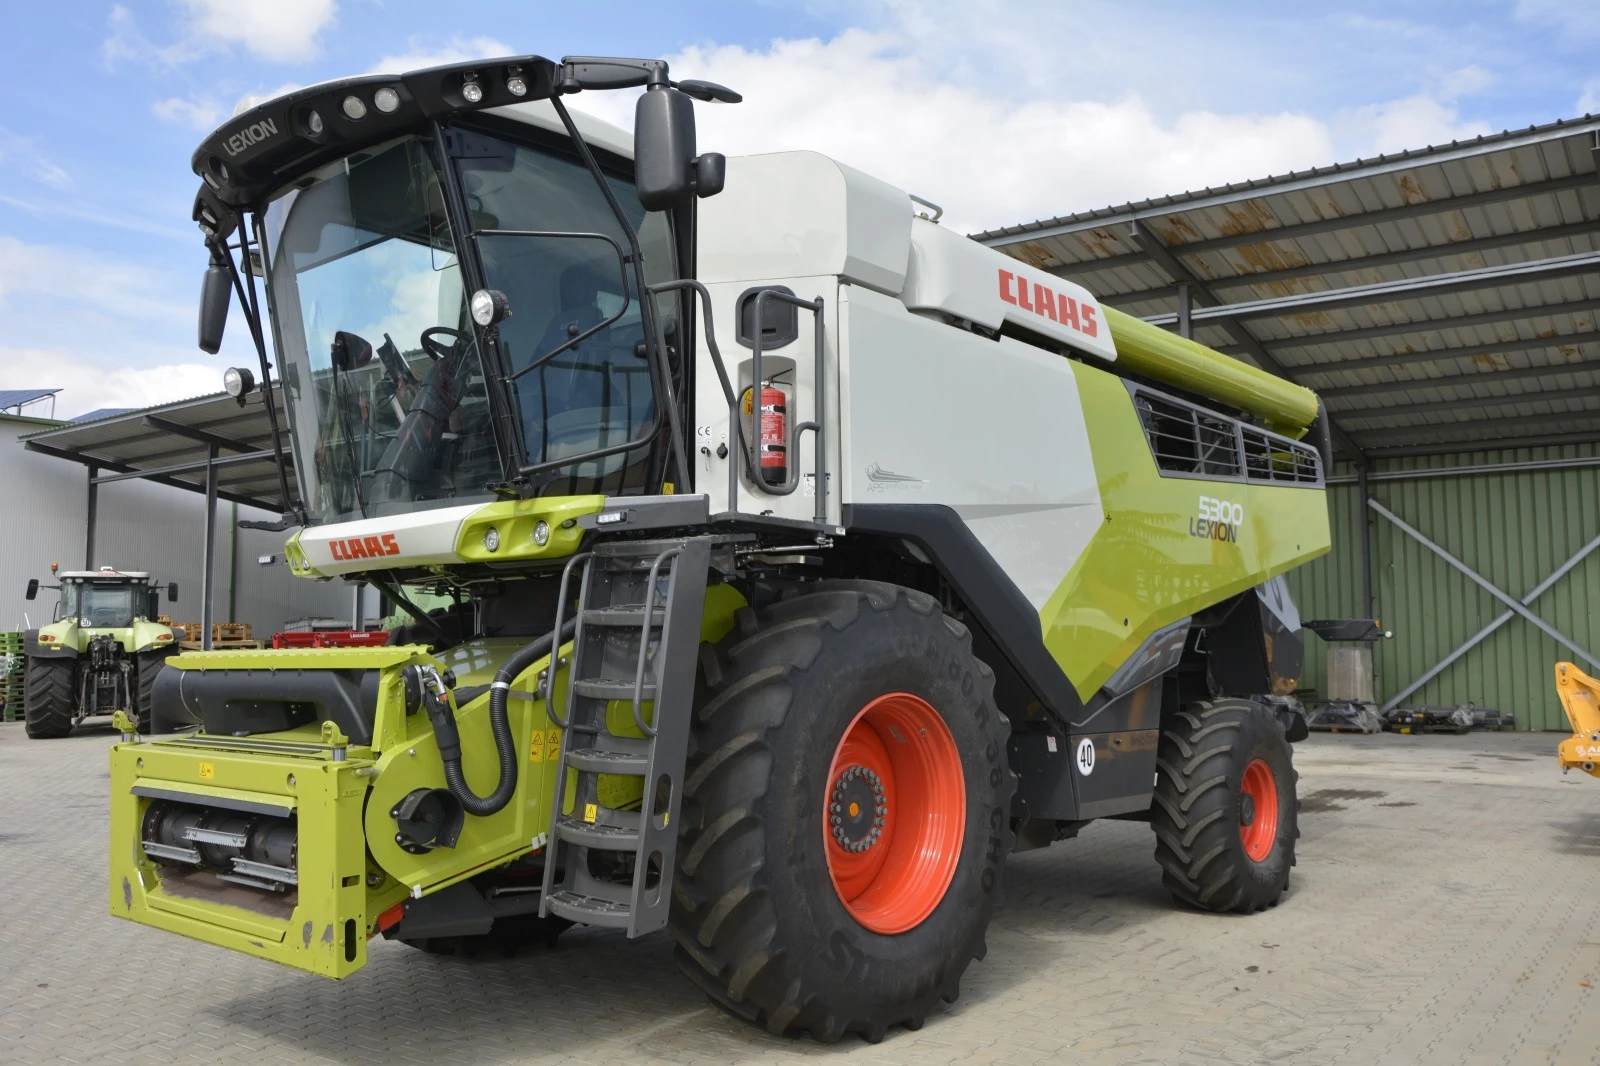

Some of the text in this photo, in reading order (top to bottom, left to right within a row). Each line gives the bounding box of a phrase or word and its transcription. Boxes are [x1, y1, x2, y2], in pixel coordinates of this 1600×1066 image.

[222, 117, 278, 156] LEXION
[998, 268, 1097, 338] CLAAS
[1198, 495, 1244, 526] 5300
[1189, 516, 1237, 543] LEXION
[328, 533, 400, 561] CLAAS
[1080, 744, 1093, 768] 40
